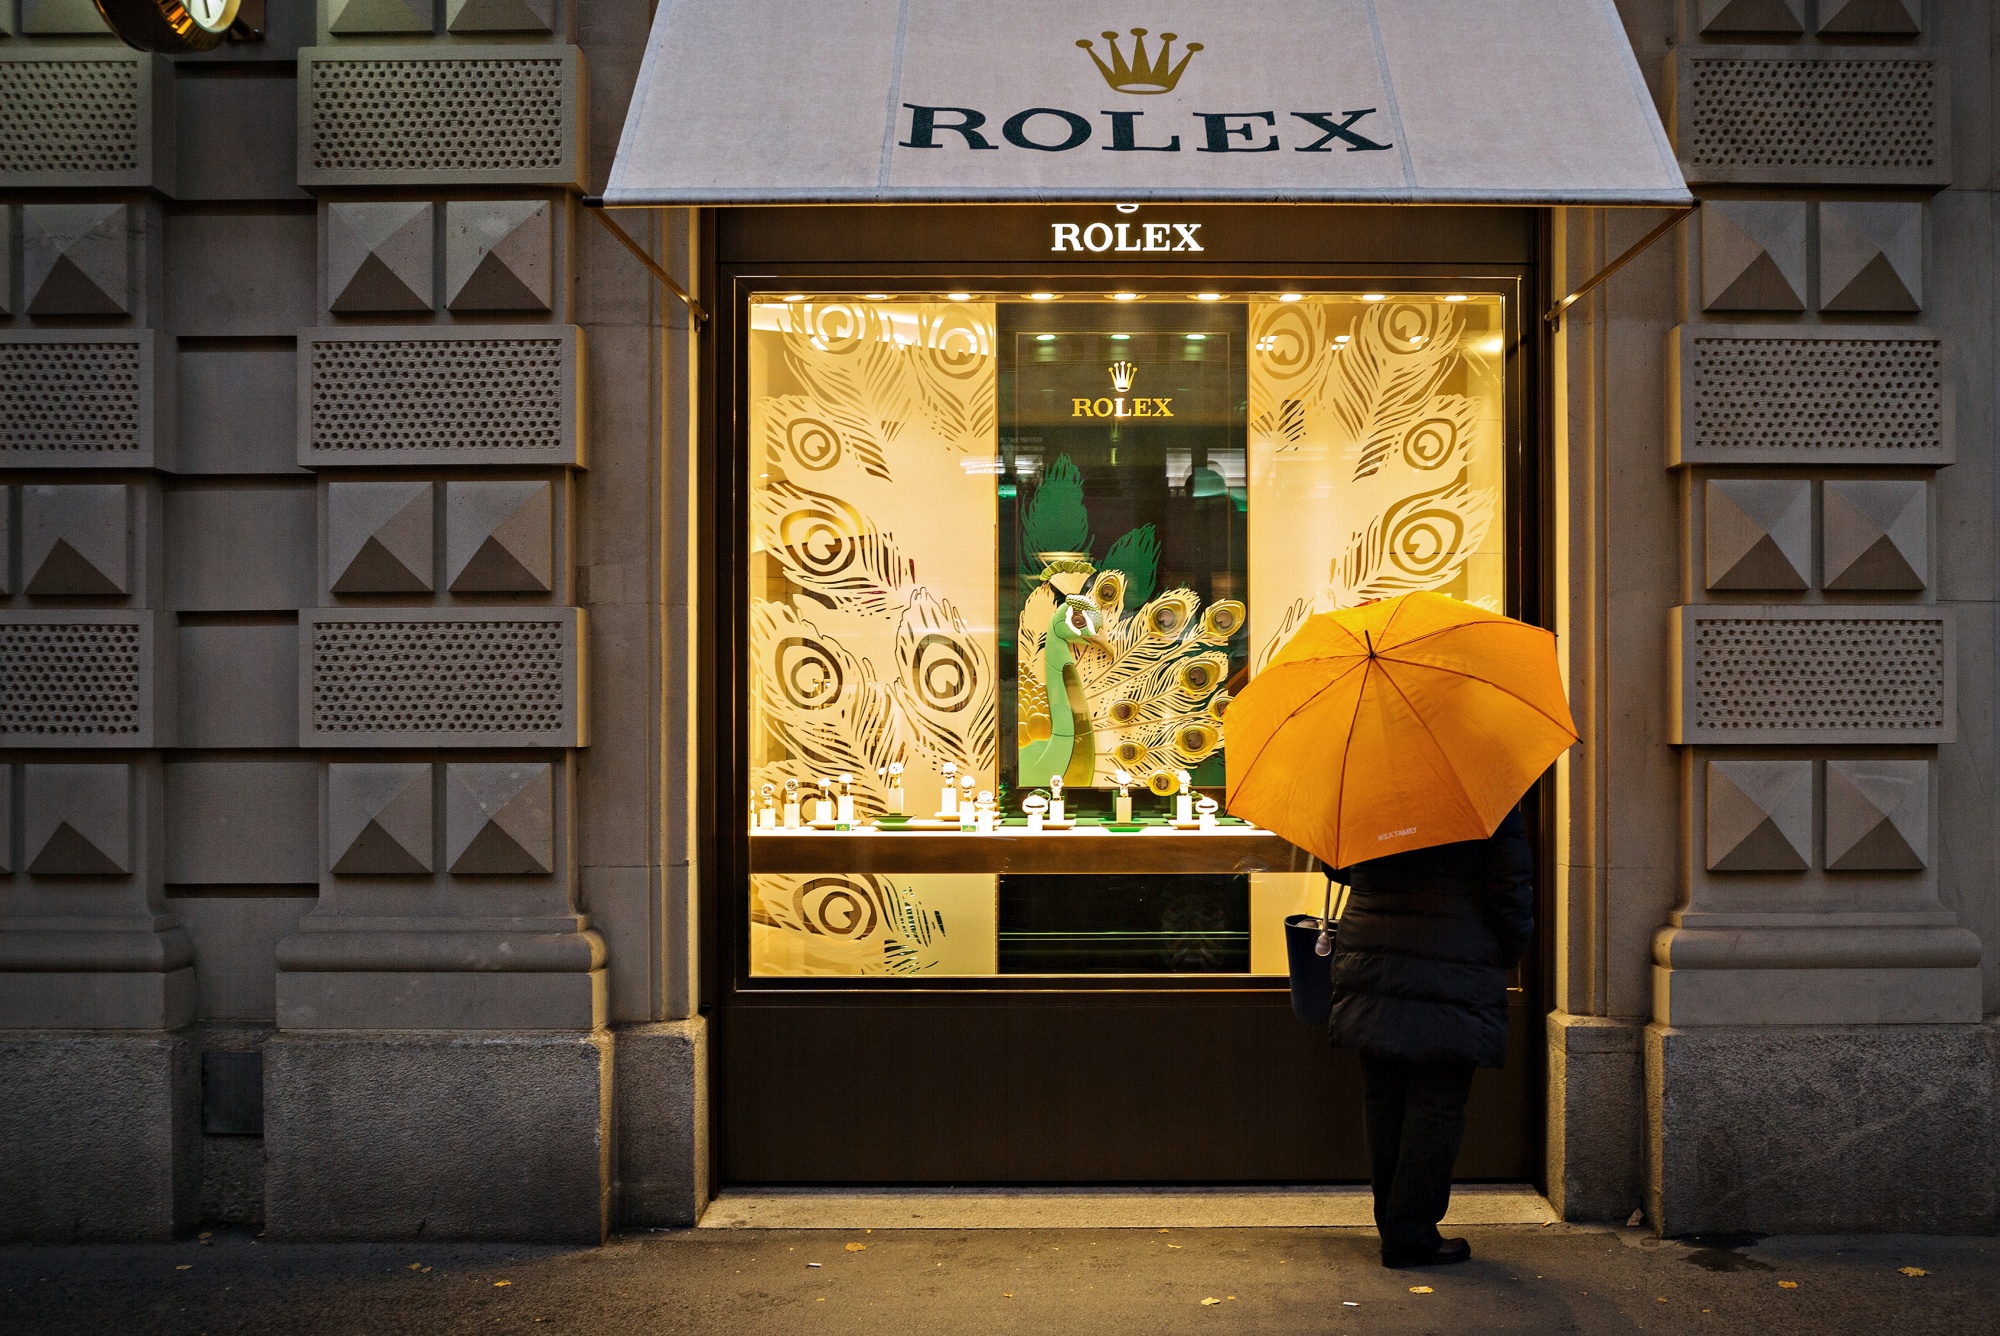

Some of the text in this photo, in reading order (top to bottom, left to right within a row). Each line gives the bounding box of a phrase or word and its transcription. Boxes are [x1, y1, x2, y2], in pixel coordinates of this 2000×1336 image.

[898, 103, 1393, 152] ROLEX
[1051, 223, 1204, 252] ROLEX
[1072, 398, 1174, 417] ROLEX
[1377, 832, 1394, 842] IKEA
